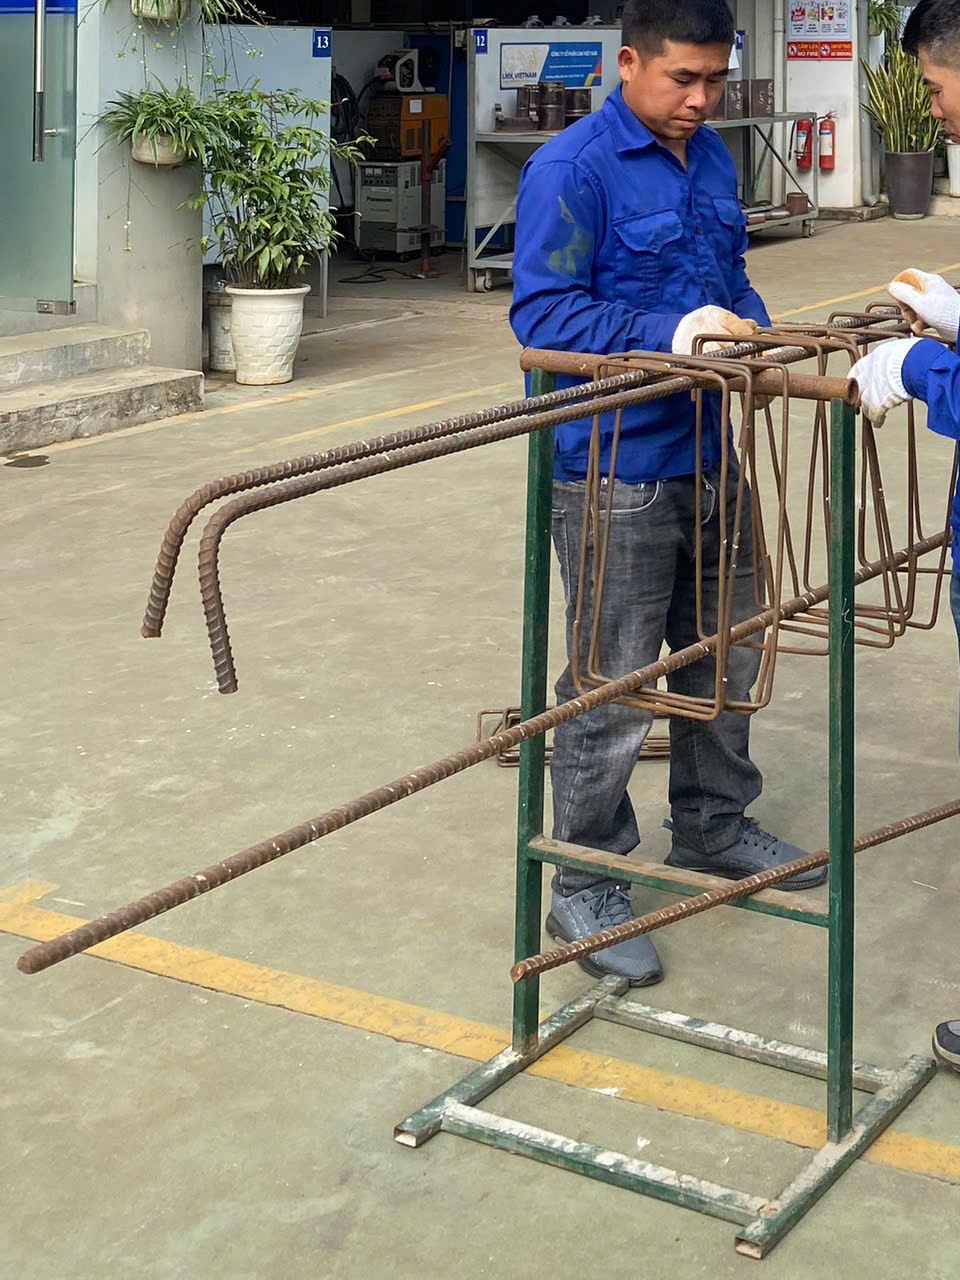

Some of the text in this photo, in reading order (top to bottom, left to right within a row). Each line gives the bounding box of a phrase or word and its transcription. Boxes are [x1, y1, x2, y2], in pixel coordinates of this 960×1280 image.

[316, 35, 329, 49] 13
[476, 35, 485, 47] 12
[502, 72, 514, 80] LMK
[514, 71, 537, 79] VIETNAM
